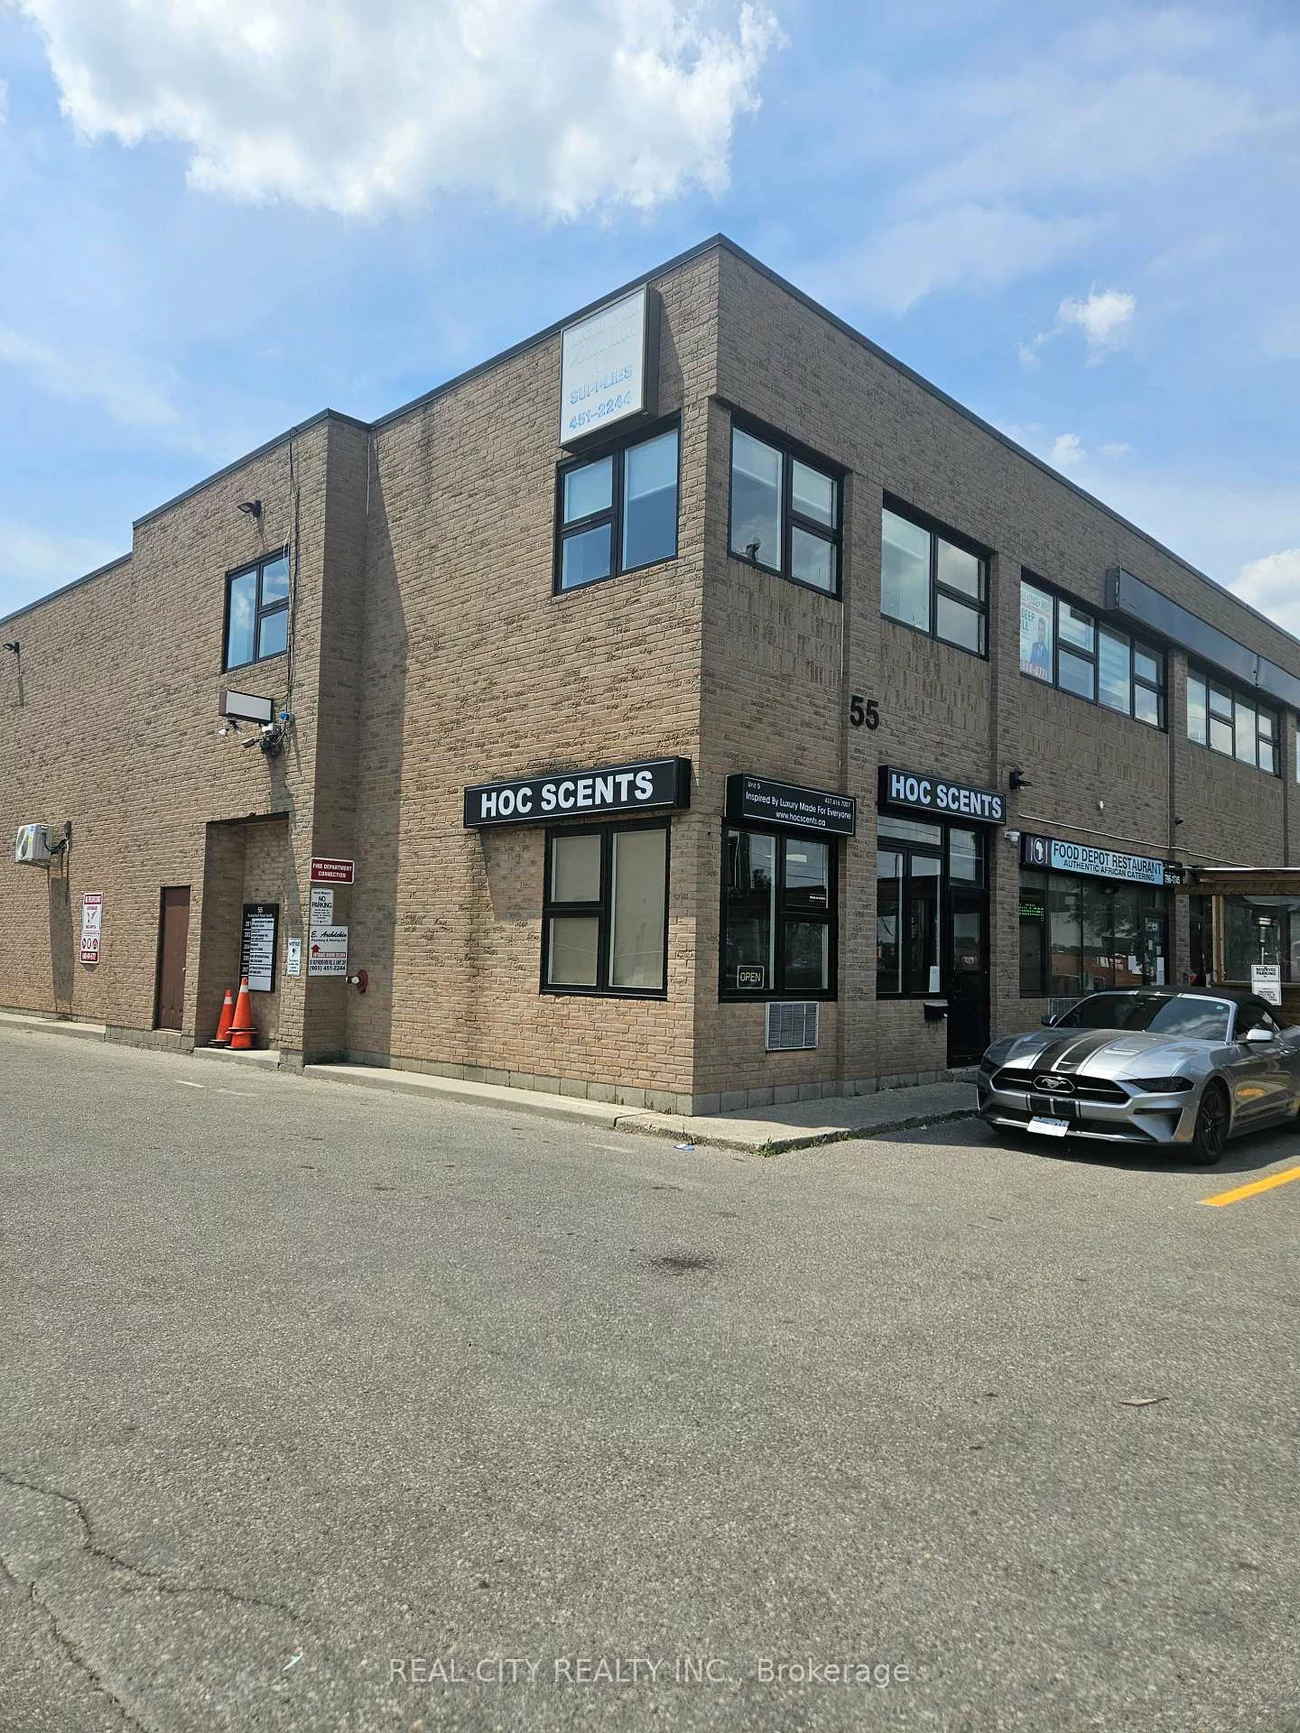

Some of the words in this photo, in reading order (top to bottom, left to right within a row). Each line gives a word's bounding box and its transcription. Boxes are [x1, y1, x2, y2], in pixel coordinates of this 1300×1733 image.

[850, 695, 879, 730] 55
[481, 787, 533, 819] HOC
[541, 770, 654, 811] SCENTS
[745, 791, 771, 804] Inspired
[772, 796, 778, 807] By
[780, 798, 798, 811] Luxury
[799, 802, 816, 813] Made
[817, 805, 826, 815] For
[827, 807, 851, 820] Everyone
[891, 774, 931, 805] HOC
[936, 784, 1002, 819] SCENTS
[776, 811, 826, 826] www.hocscents.ca
[323, 864, 352, 872] DEPARTMENT
[1053, 843, 1079, 860] FOOD
[1081, 848, 1109, 865] DEPOT
[1112, 854, 1162, 875] RESTAURANT
[1063, 859, 1100, 872] AUTHENTIC
[1100, 865, 1126, 877] AFRICAN
[1127, 870, 1155, 881] CATERING
[318, 870, 346, 878] CONNECTION
[311, 930, 318, 938] E.
[740, 972, 761, 982] OPEN
